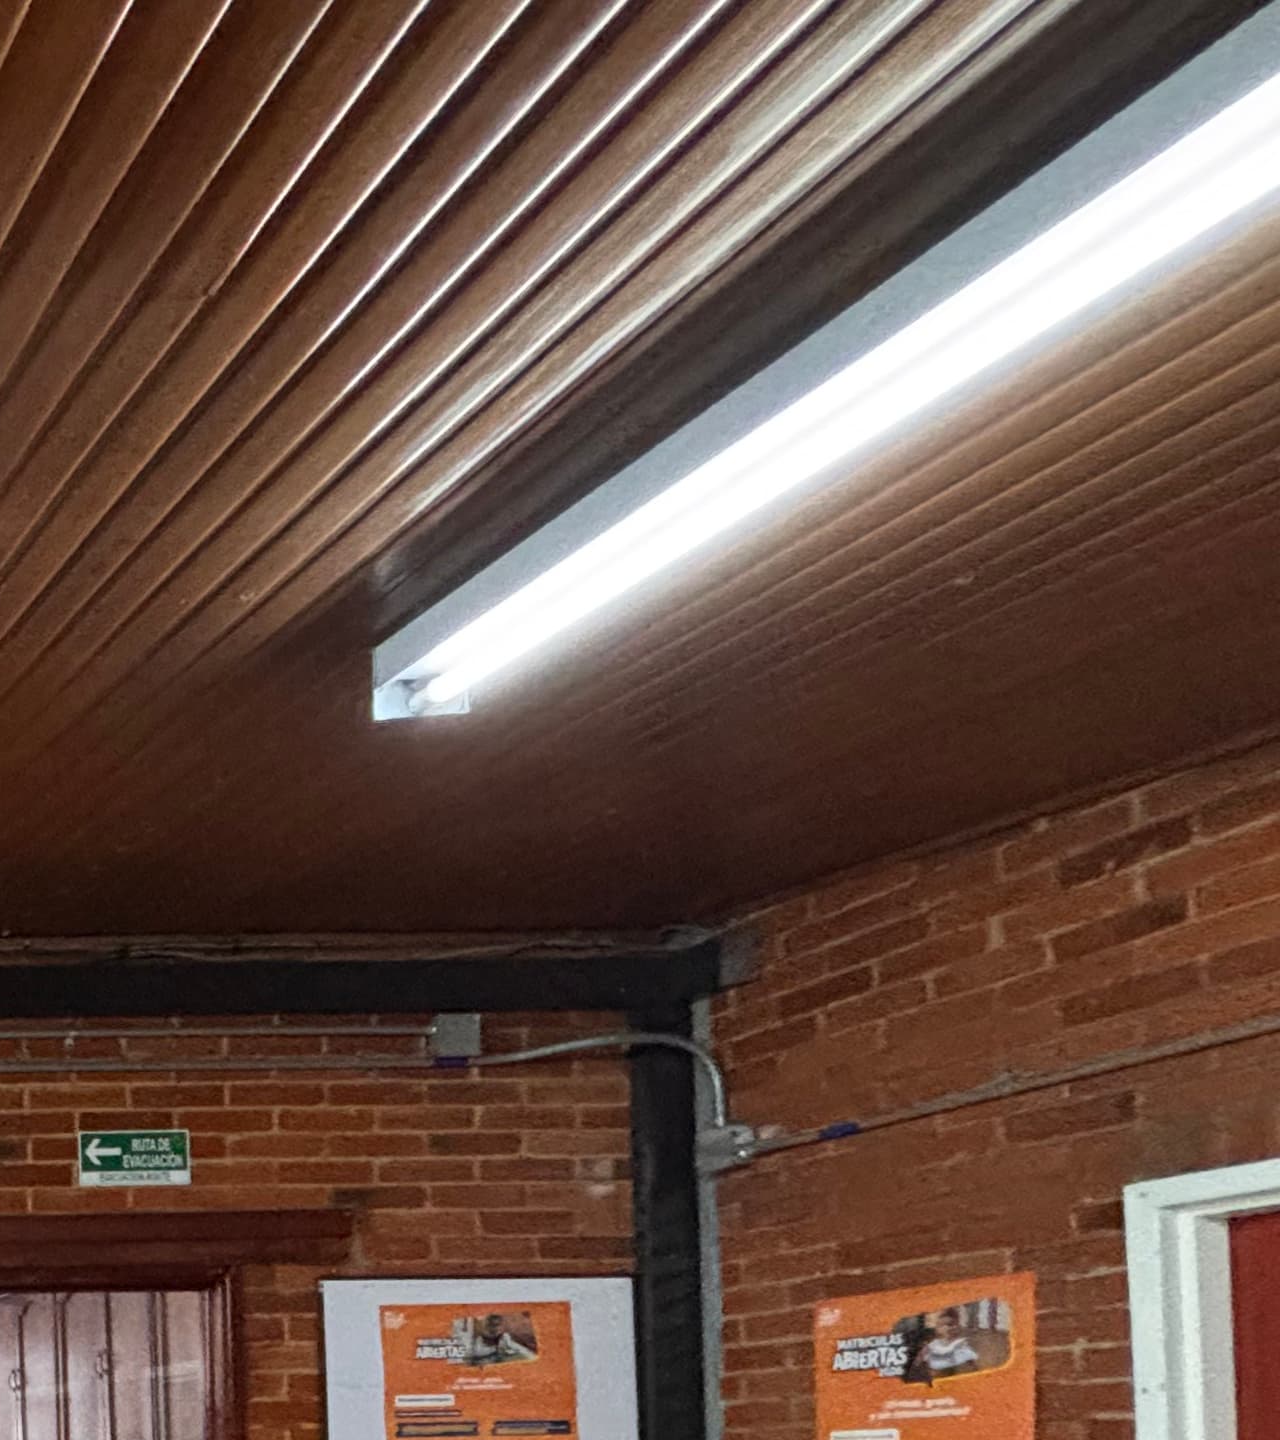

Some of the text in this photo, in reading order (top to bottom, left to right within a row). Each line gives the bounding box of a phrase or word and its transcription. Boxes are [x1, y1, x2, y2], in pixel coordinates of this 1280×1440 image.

[131, 1137, 171, 1152] RUTA DE
[832, 1347, 909, 1372] ABIERTAS
